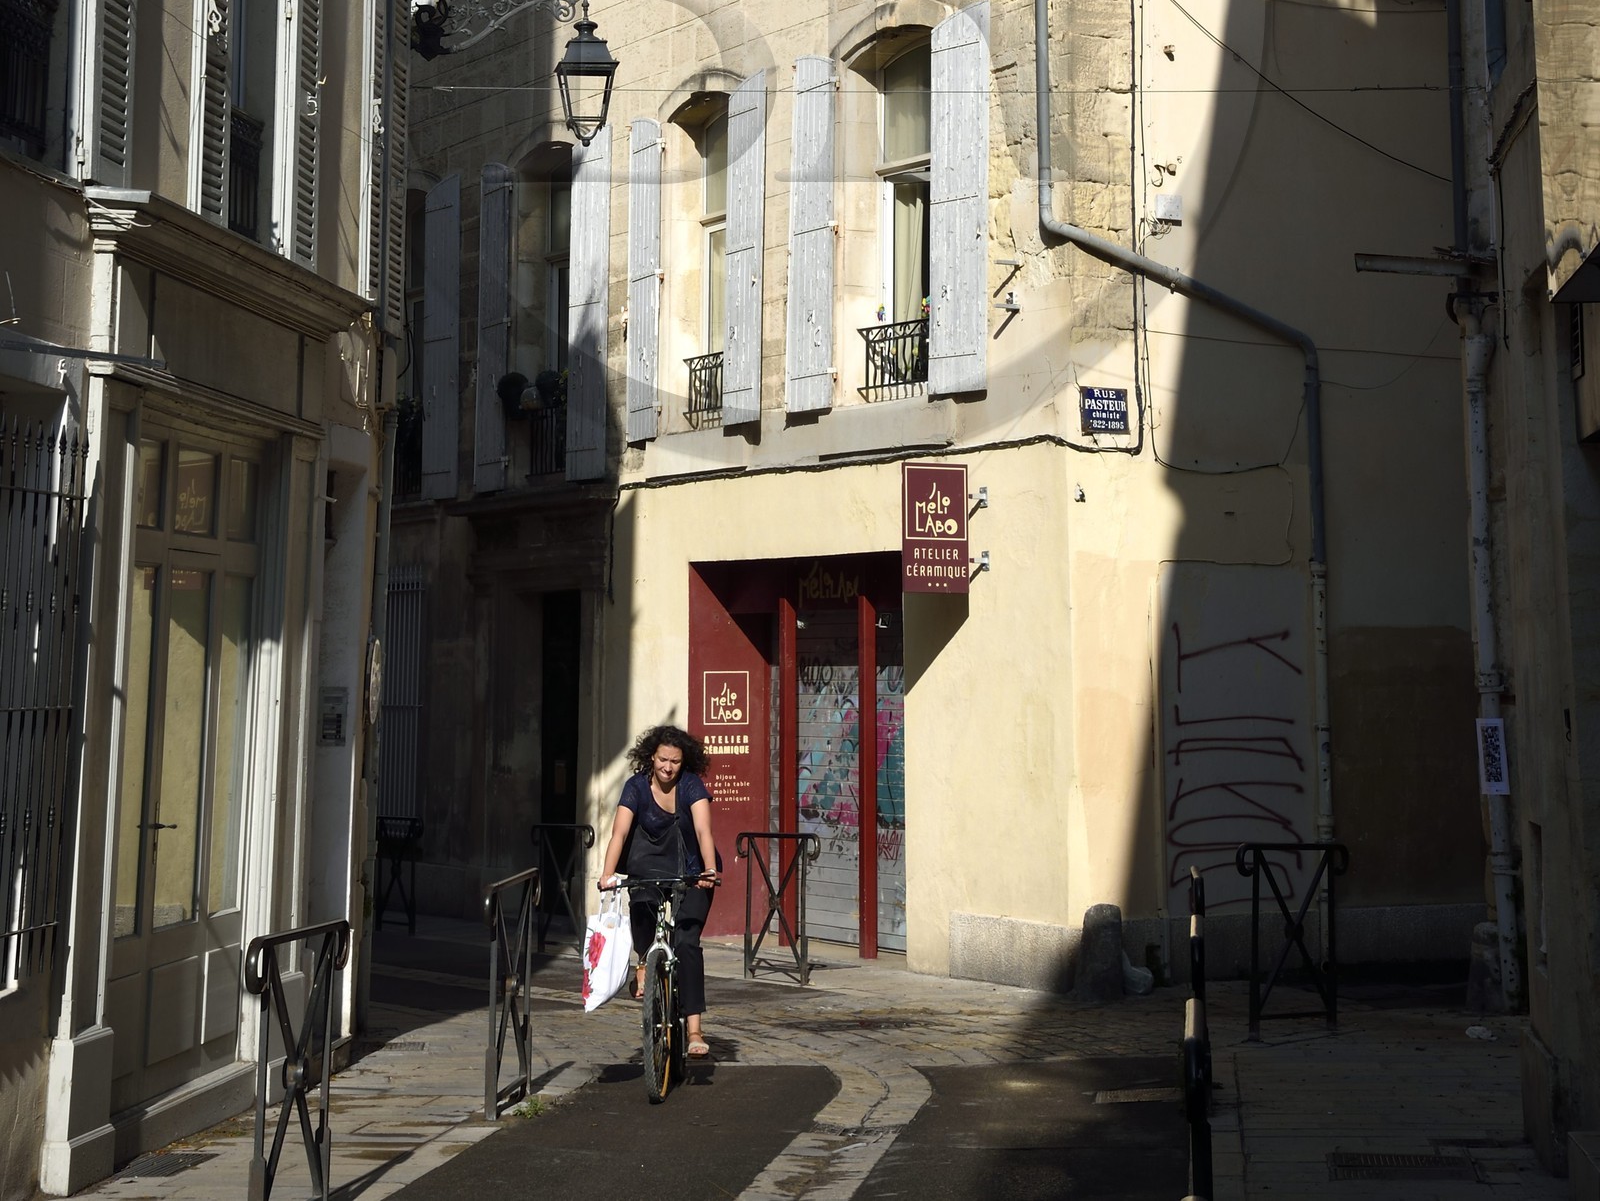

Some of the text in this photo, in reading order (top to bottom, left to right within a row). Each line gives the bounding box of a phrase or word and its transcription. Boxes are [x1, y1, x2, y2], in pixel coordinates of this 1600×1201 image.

[1094, 389, 1116, 398] RUE
[1085, 399, 1127, 411] PASTEUR
[1092, 411, 1120, 419] chimiste
[914, 548, 959, 560] ATELIER
[906, 563, 967, 579] CÉRAMIQUE
[704, 735, 749, 744] ATELIER
